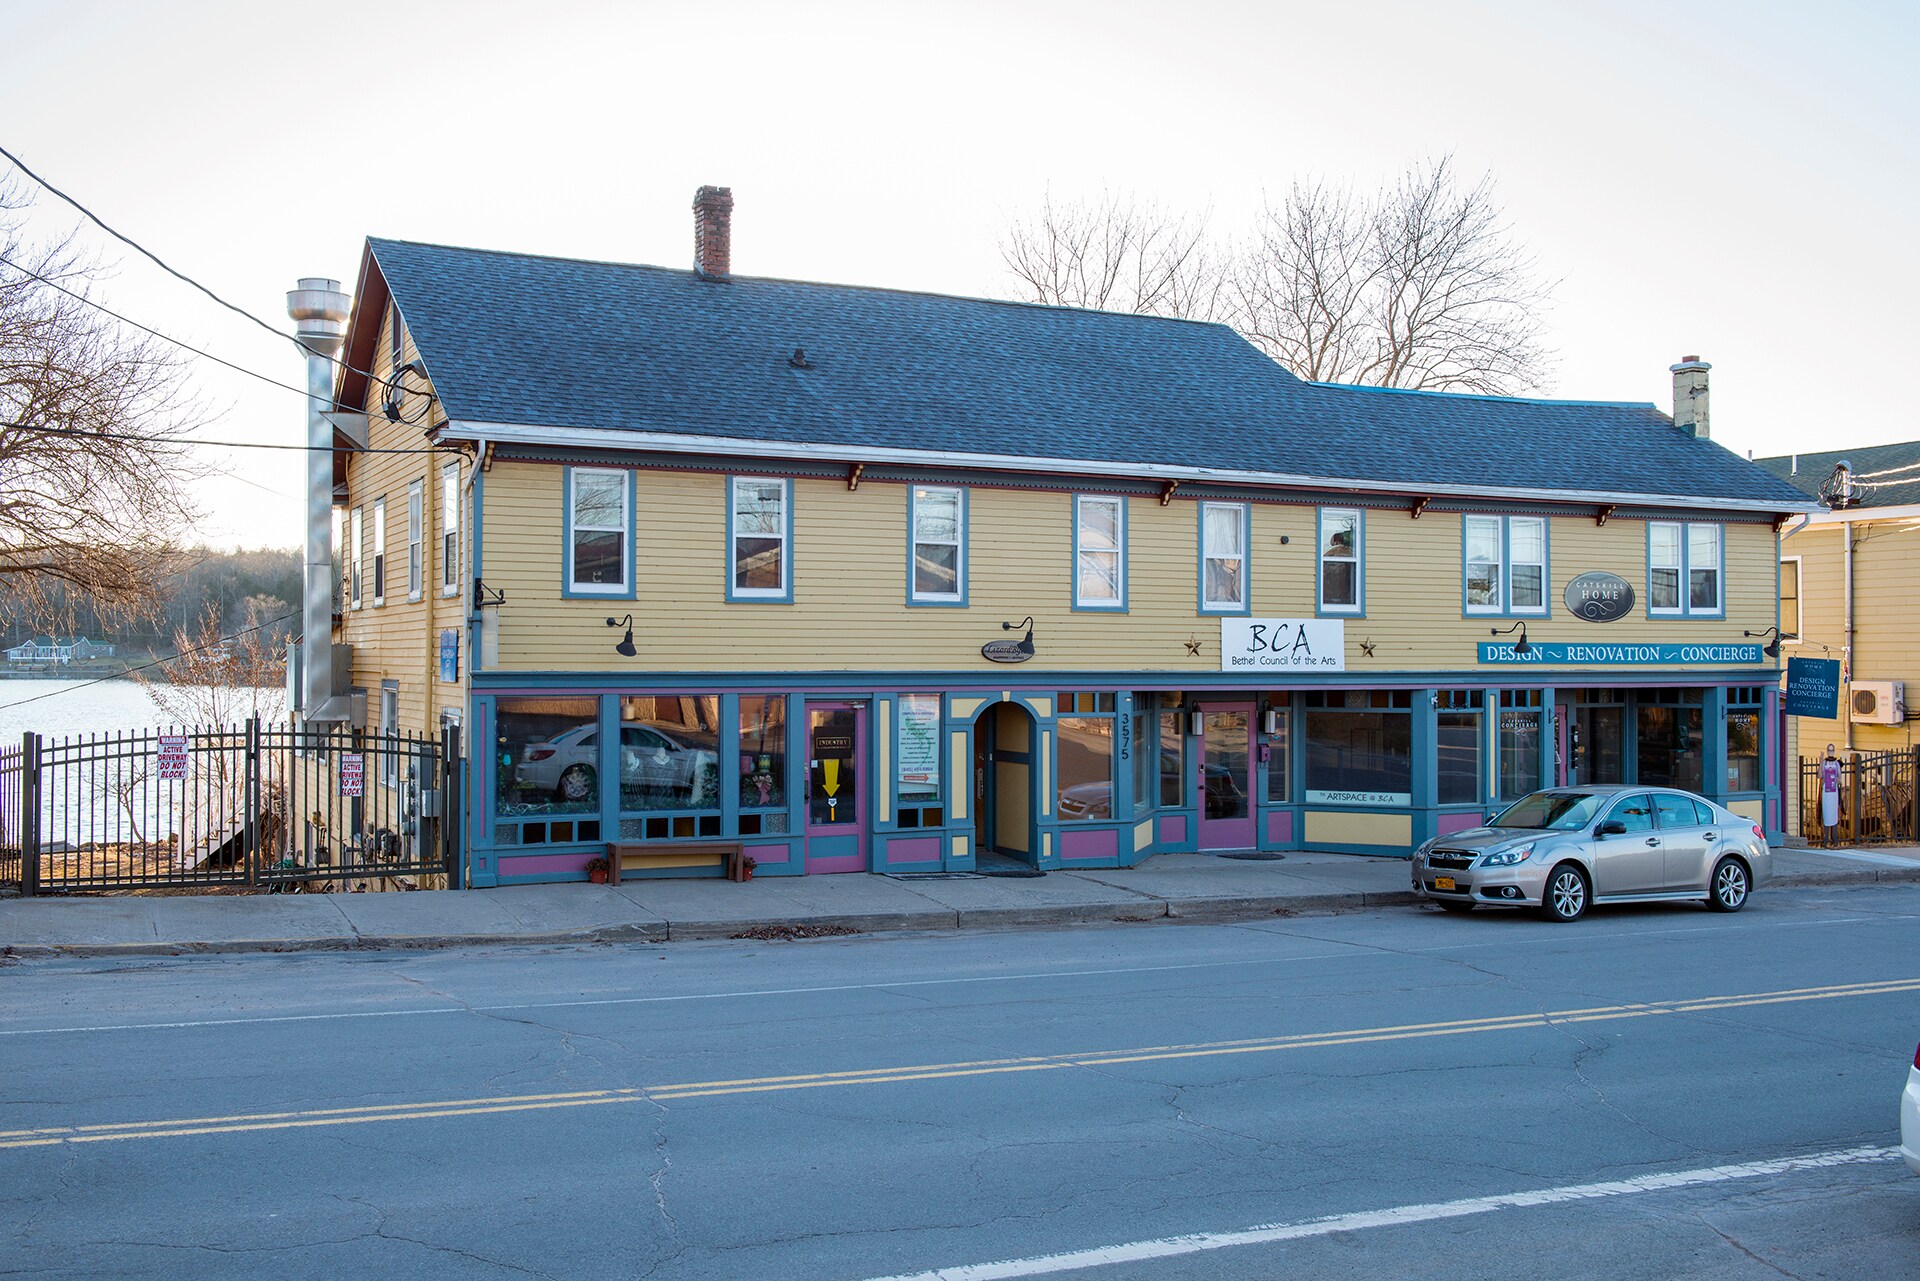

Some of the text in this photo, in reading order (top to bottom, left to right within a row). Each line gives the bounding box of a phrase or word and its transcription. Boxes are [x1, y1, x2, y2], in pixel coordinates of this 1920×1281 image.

[1582, 590, 1619, 600] HOME
[1246, 623, 1311, 659] BCA
[1487, 646, 1757, 661] DESIGN RENOVATION CONCIERGE
[1231, 656, 1337, 665] Bethel Council of the Arts
[1799, 677, 1826, 685] DESIGN
[1789, 683, 1836, 692] RENOVATION
[1791, 690, 1832, 699] CONCIERGE
[161, 736, 186, 744] WARNING
[1122, 713, 1130, 760] 3575
[160, 762, 170, 770] DO
[161, 770, 186, 779] BLOCK!
[1326, 792, 1367, 802] ARTSPACE
